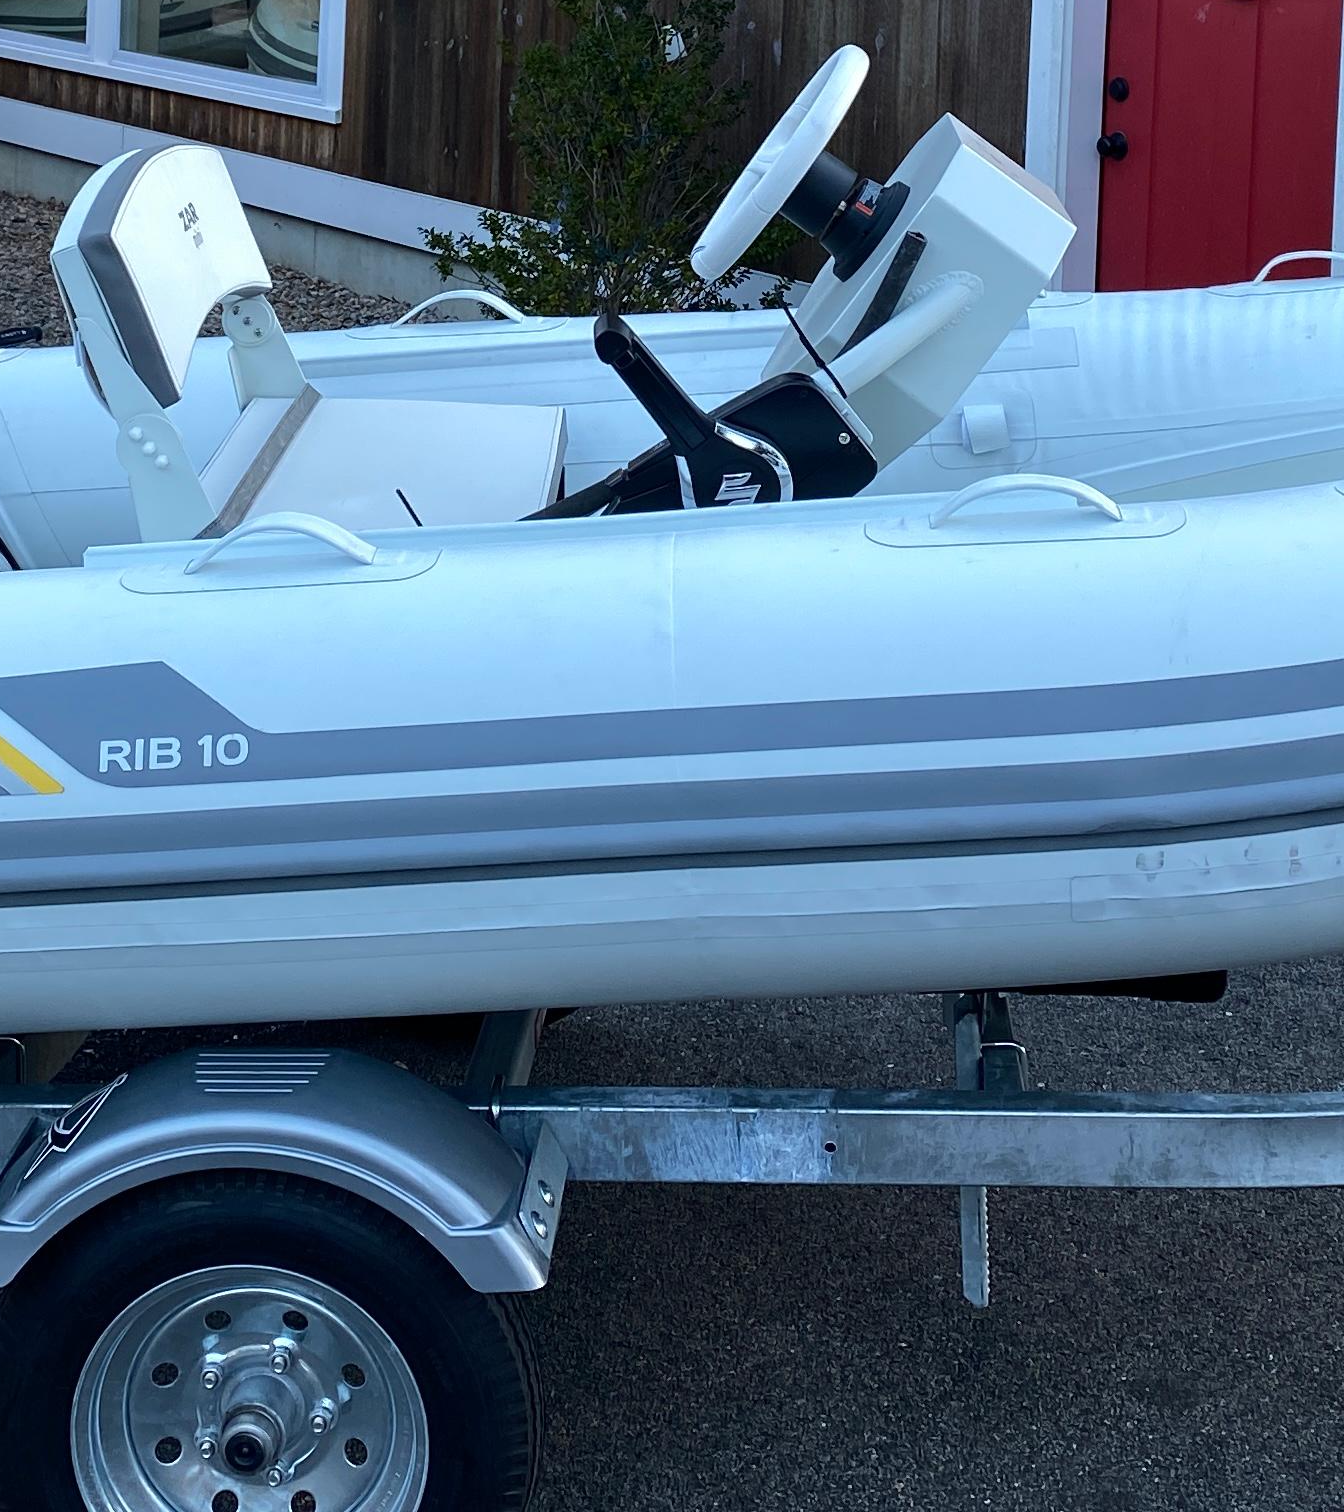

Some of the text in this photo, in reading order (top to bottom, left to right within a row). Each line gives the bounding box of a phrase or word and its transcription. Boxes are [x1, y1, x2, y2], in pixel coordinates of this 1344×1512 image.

[178, 202, 200, 232] ZAR
[97, 732, 250, 774] RIB 10
